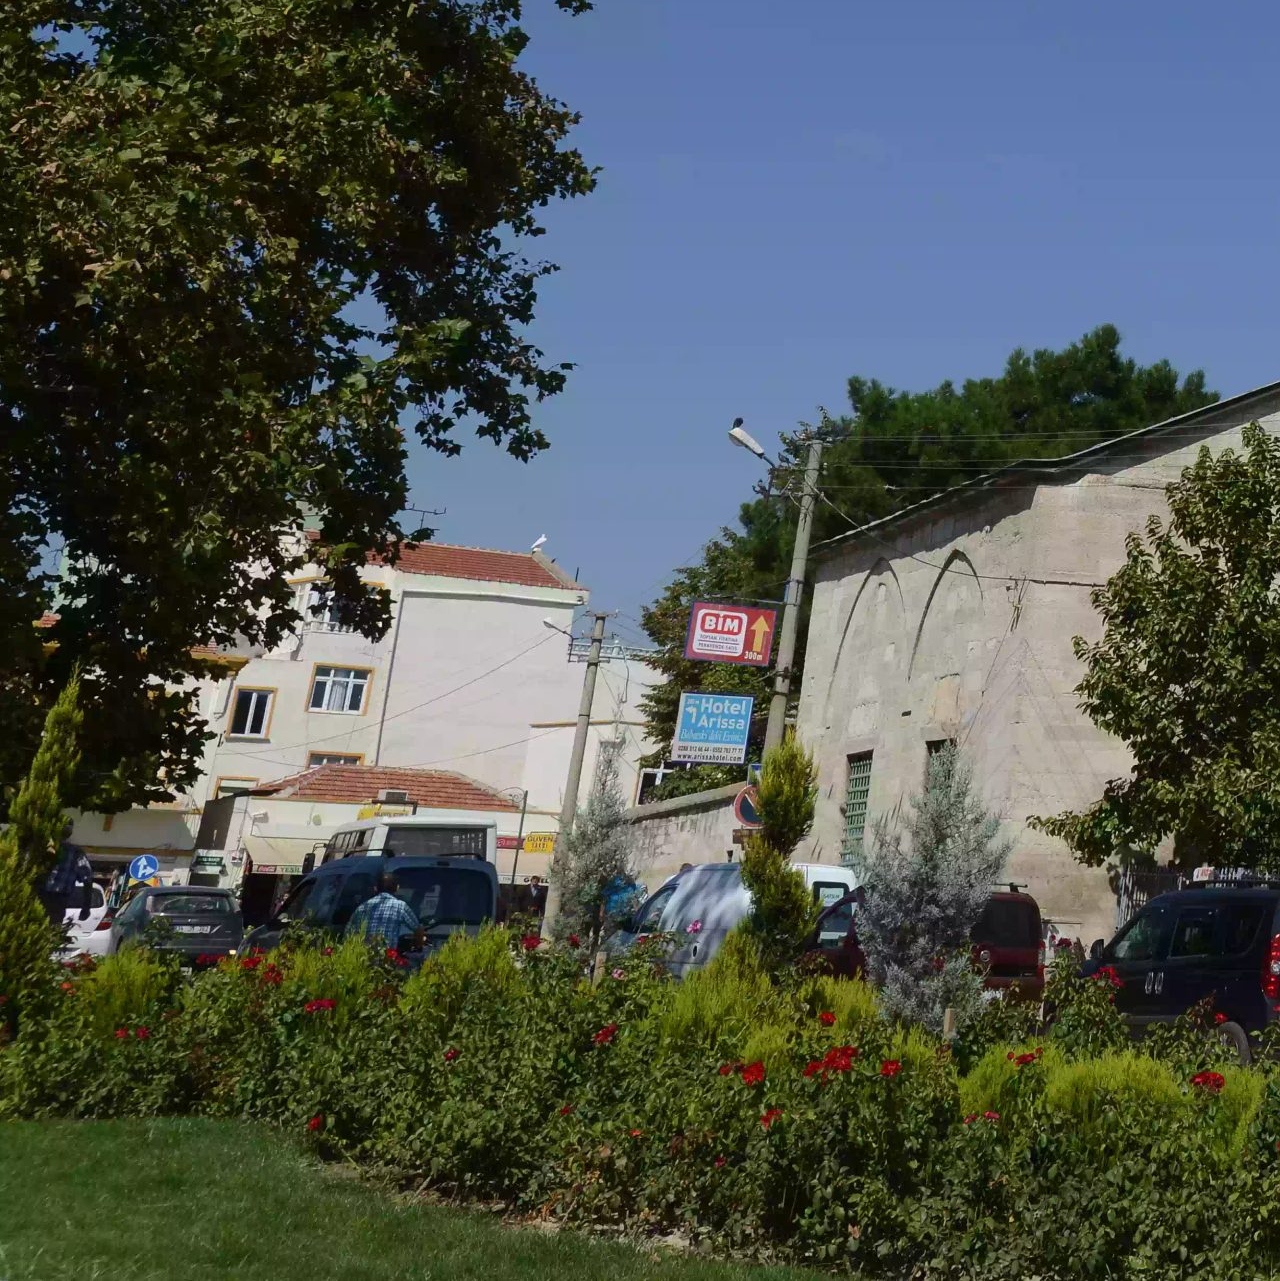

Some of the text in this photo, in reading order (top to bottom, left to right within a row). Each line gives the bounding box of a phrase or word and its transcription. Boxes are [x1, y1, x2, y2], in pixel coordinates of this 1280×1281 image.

[704, 614, 739, 633] BİM
[744, 651, 763, 661] 300m
[701, 698, 746, 716] Hotel
[697, 714, 745, 729] Arissa
